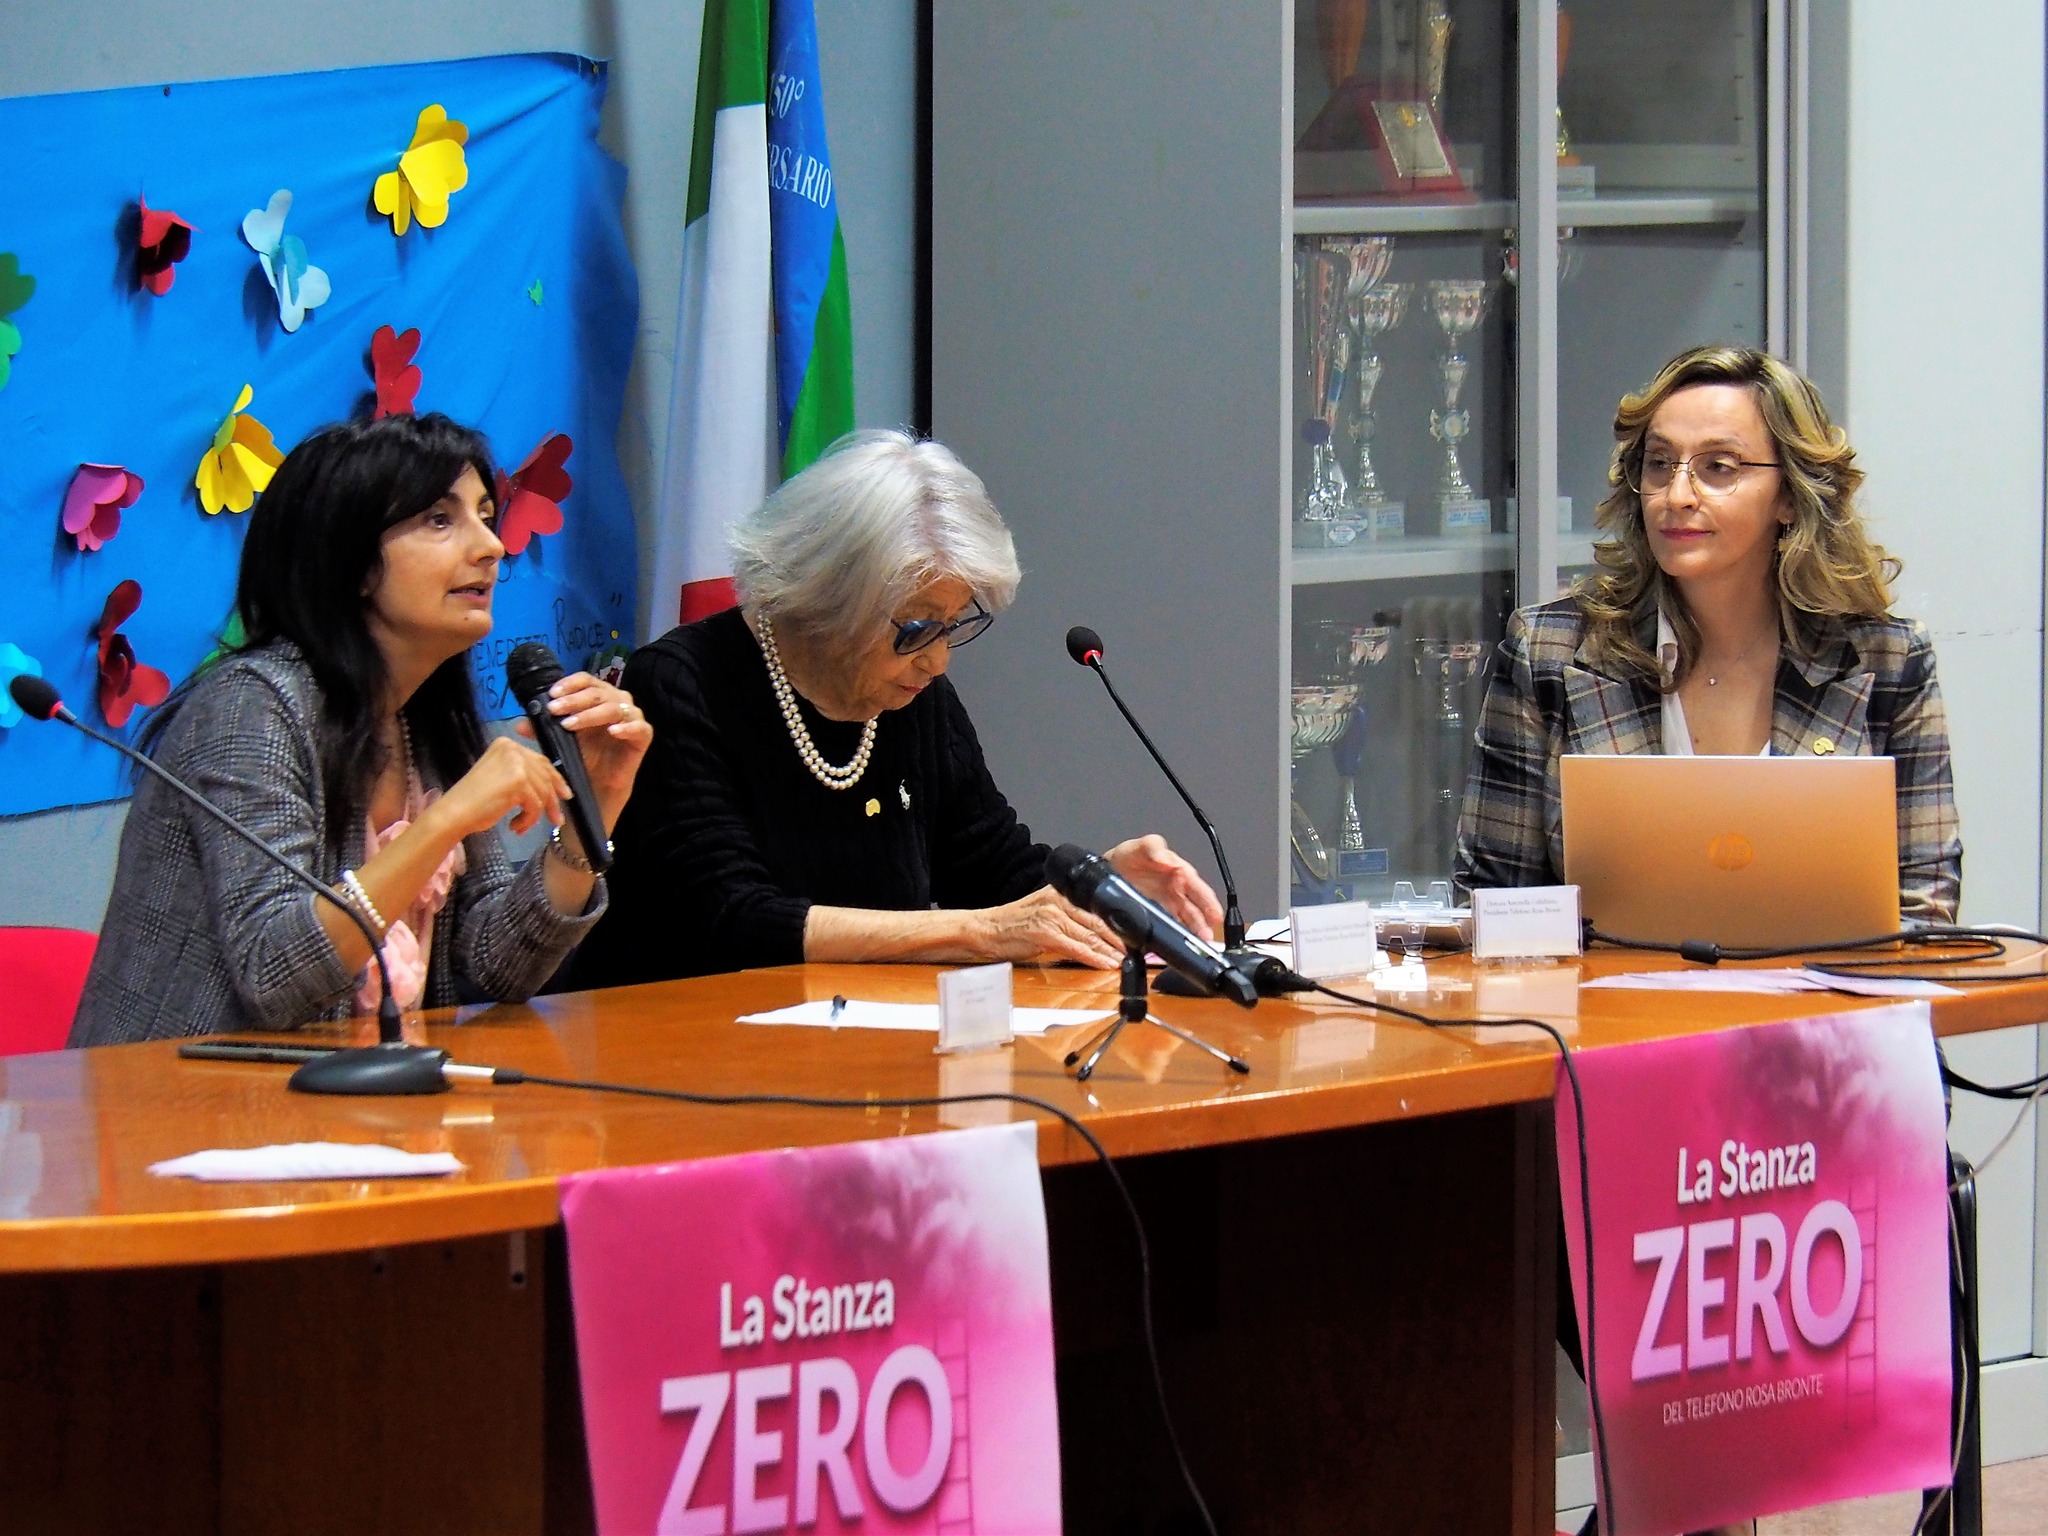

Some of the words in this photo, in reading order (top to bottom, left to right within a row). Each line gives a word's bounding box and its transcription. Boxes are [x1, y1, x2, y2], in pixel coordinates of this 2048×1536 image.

[768, 143, 833, 208] RSARIO
[1677, 1146, 1713, 1205] La
[1718, 1138, 1817, 1198] Stanza
[720, 1281, 766, 1347] La
[771, 1273, 895, 1341] Stanza
[1631, 1200, 1862, 1381] ZERO
[1663, 1401, 1685, 1426] DEL
[1685, 1388, 1744, 1420] TELEFONO
[1745, 1382, 1776, 1409] ROSA
[1776, 1373, 1824, 1403] BRONTE
[657, 1343, 953, 1536] ZERO
